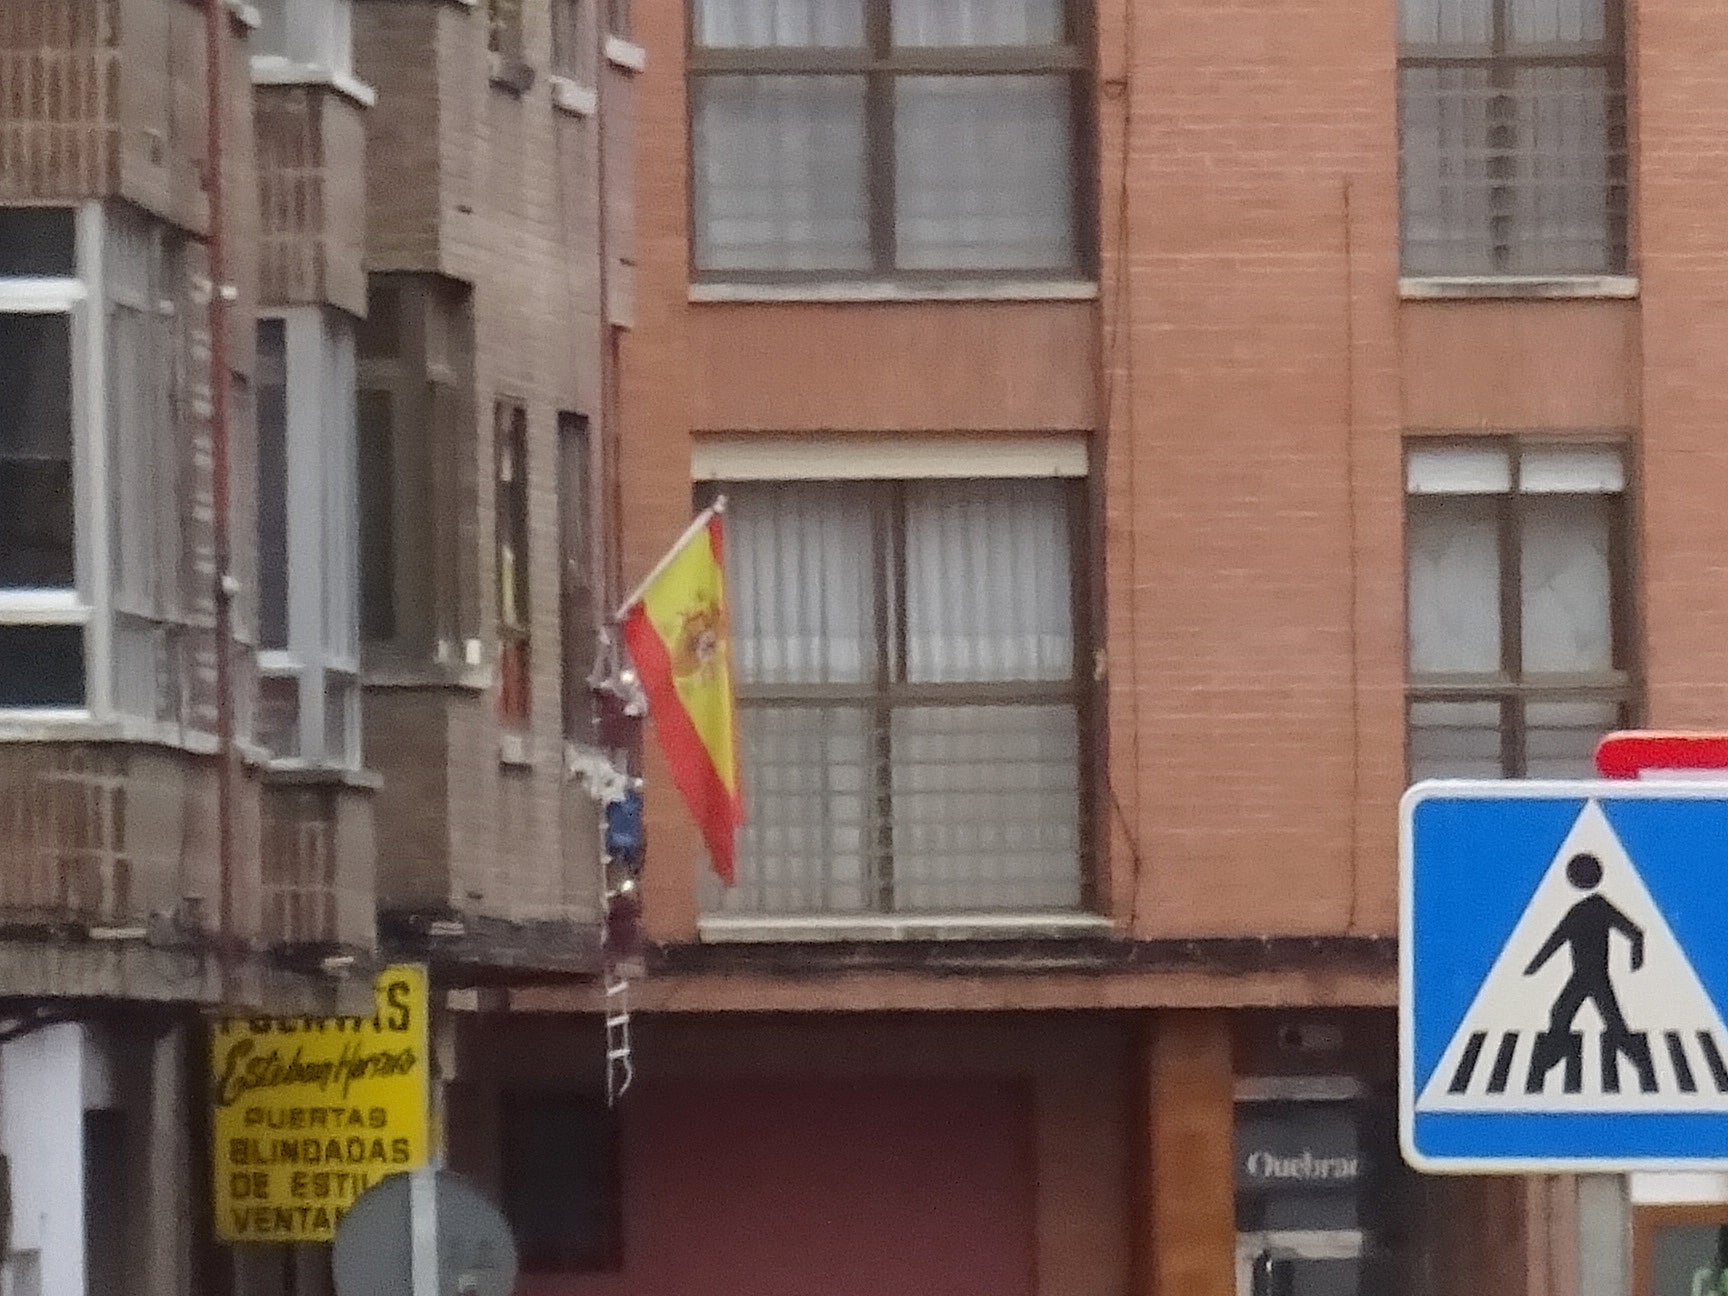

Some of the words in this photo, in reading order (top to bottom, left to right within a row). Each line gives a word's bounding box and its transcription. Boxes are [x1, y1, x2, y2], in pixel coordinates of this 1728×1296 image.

[244, 1106, 388, 1129] PUERTAS
[229, 1136, 411, 1165] BLINDADAS
[230, 1171, 269, 1200] DE
